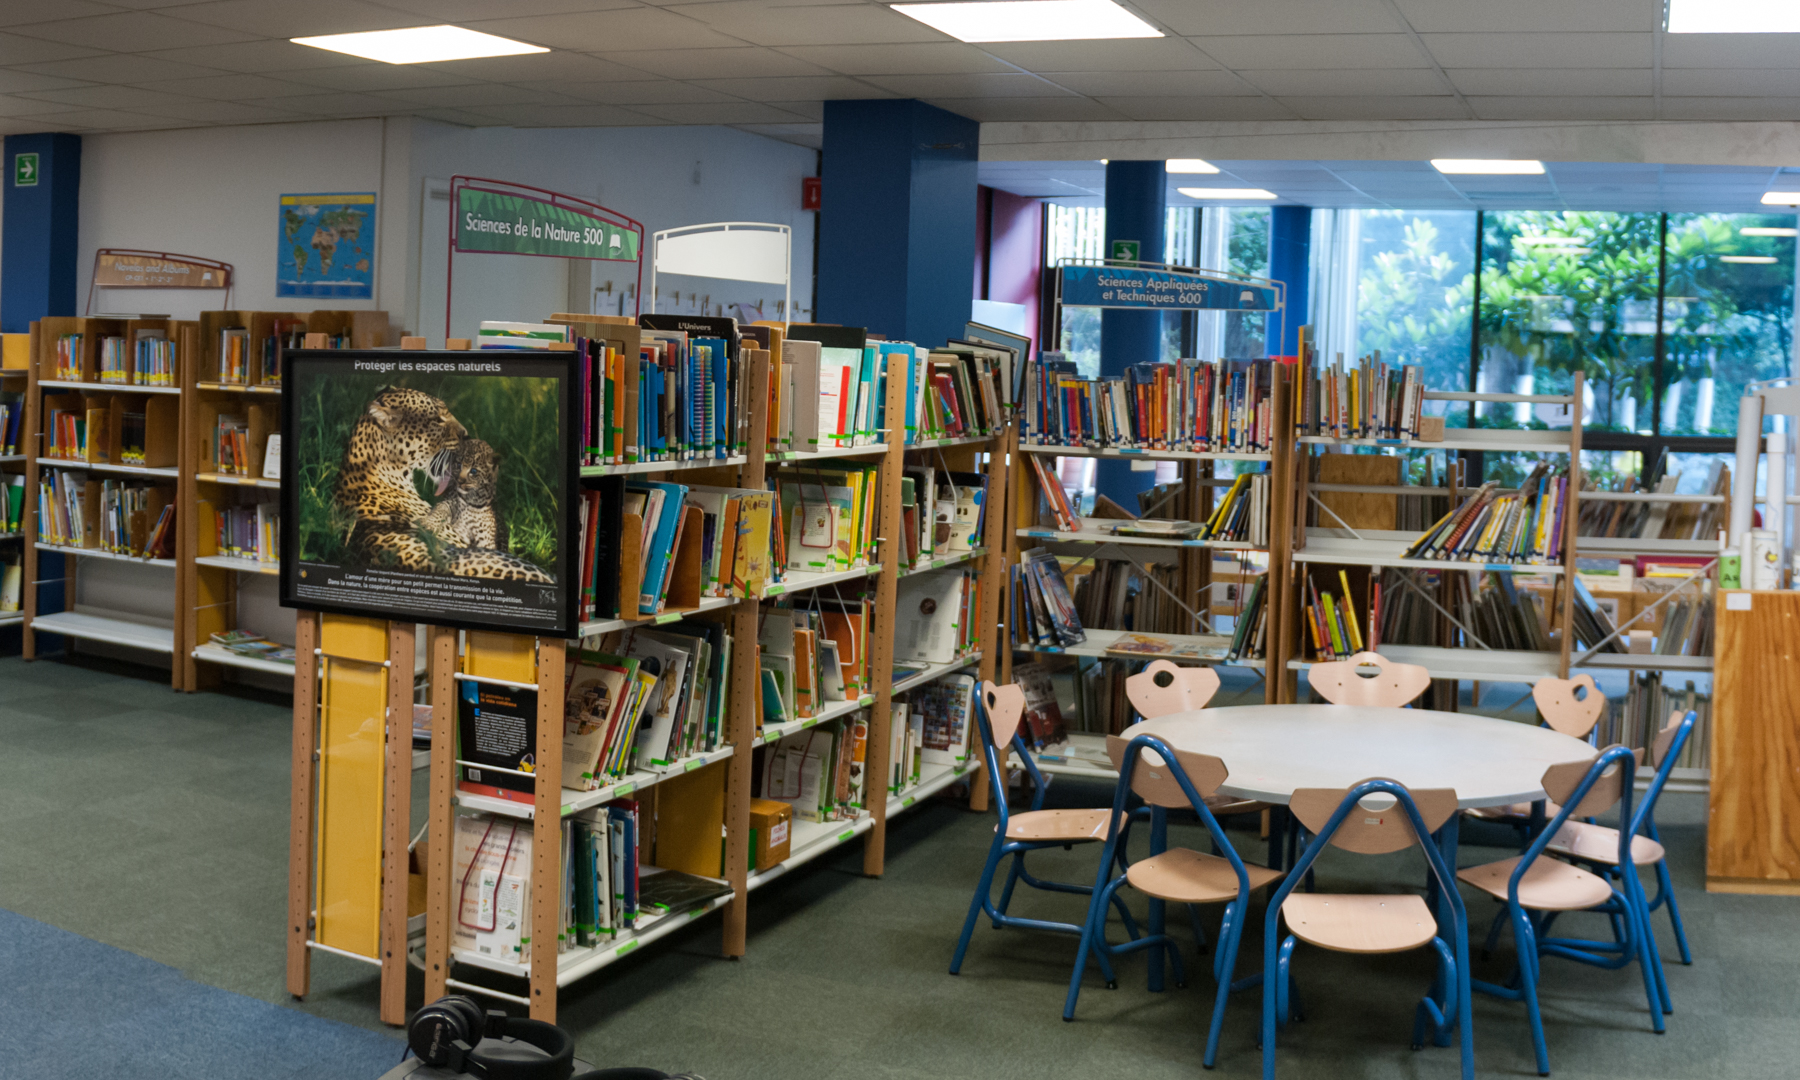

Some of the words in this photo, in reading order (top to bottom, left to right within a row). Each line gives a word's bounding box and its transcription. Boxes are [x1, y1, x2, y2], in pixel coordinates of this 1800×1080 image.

[466, 213, 511, 235] Sciences
[514, 217, 528, 237] de
[531, 219, 541, 238] la
[545, 222, 580, 243] Nature
[583, 228, 603, 245] 500
[145, 264, 160, 273] and
[162, 263, 190, 274] Albums
[1097, 275, 1143, 288] Sciences
[1146, 278, 1208, 292] Appliquées
[1102, 291, 1113, 300] et
[1117, 290, 1175, 304] Techniques
[1178, 293, 1201, 304] 600
[678, 322, 711, 331] L'Univers
[354, 360, 396, 373] Protéger
[399, 361, 413, 371] les
[415, 362, 456, 373] espaces
[458, 361, 501, 372] naturels
[346, 580, 363, 588] nature,
[369, 583, 396, 591] coopération
[492, 595, 523, 604] compétition.
[425, 581, 442, 589] permet
[449, 584, 481, 592] transmission
